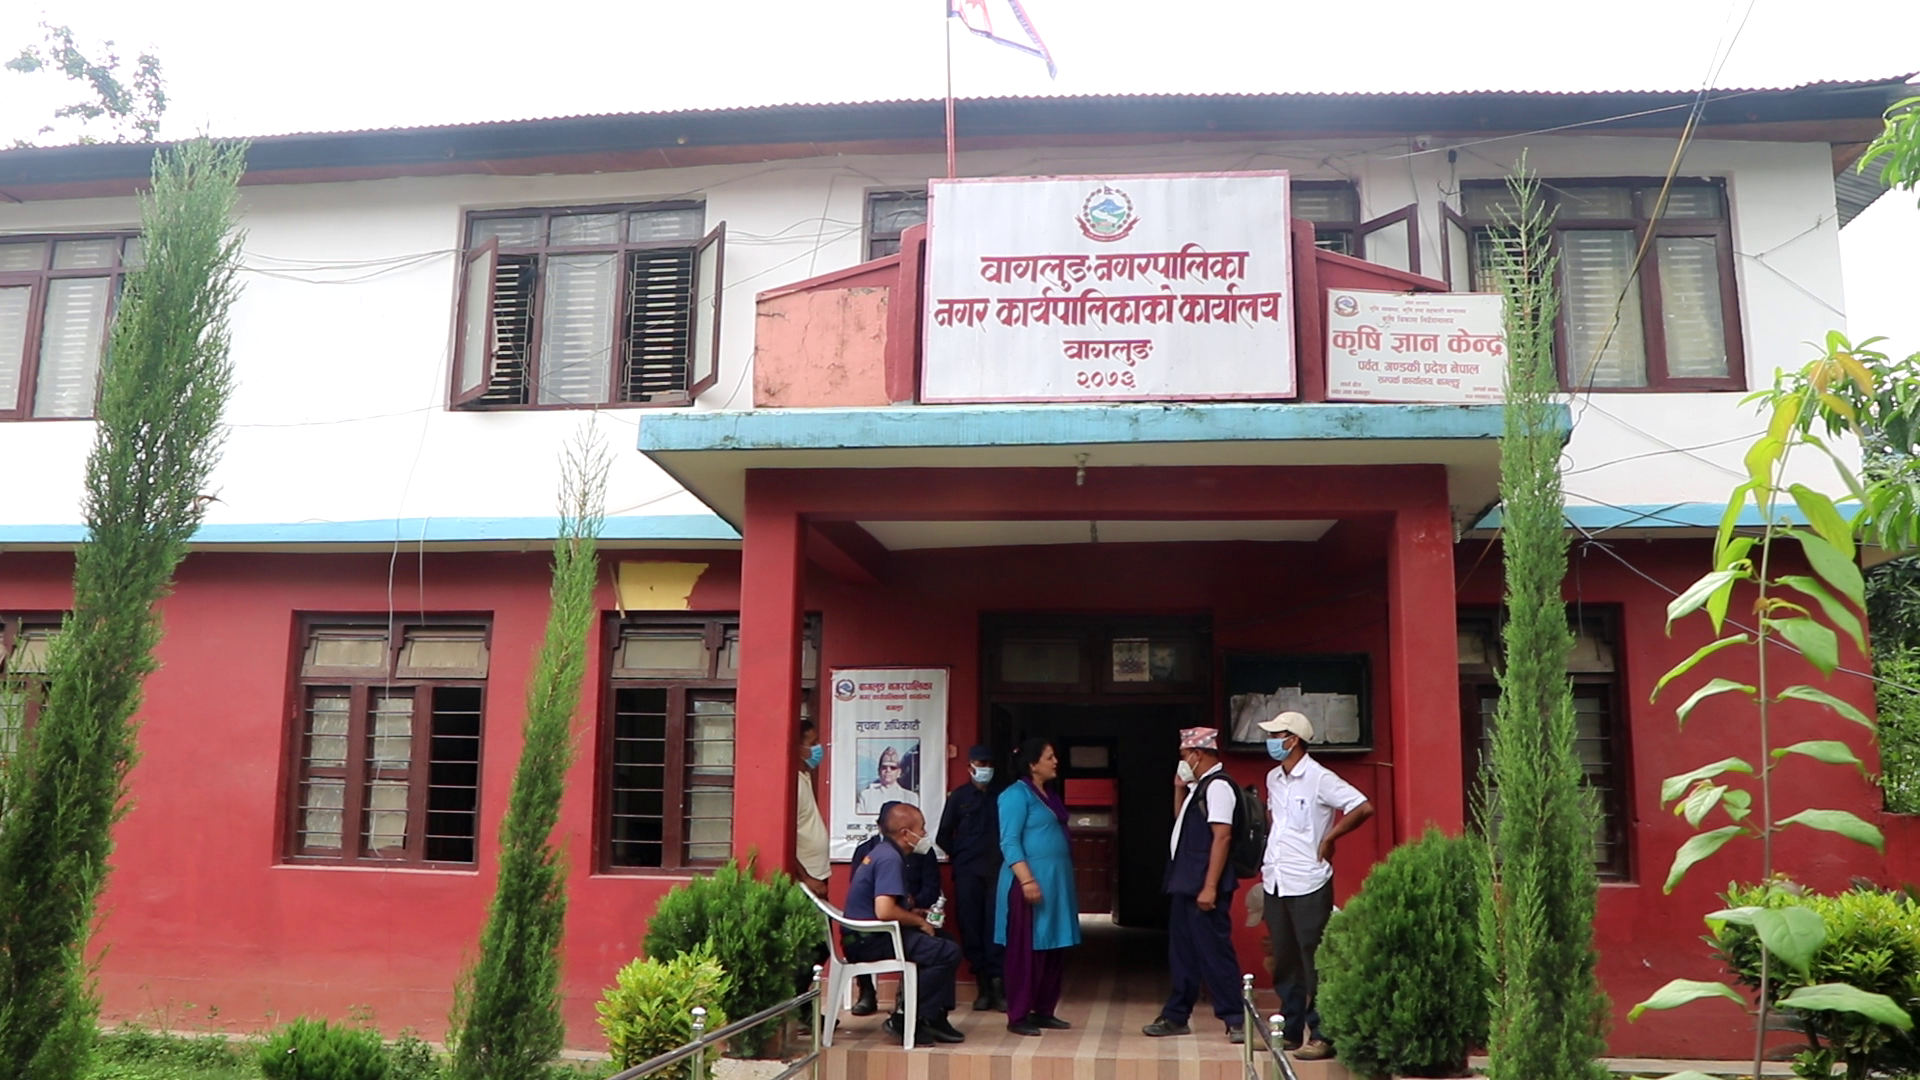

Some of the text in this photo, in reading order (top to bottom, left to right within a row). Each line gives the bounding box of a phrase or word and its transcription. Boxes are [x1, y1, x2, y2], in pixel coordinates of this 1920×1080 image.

[1094, 243, 1249, 283] नगरपालिका
[934, 283, 1282, 333] नगर कार्यपालिकाको कार्यालय
[1332, 325, 1503, 357] कृषि ज्ञान केन्द्र
[1076, 370, 1137, 388] २०७३
[1384, 360, 1420, 373] गण्डकी
[1424, 360, 1447, 374] प्रदेश
[1450, 360, 1479, 375] नेपाल
[856, 719, 921, 732] सूचना अधिकारी
